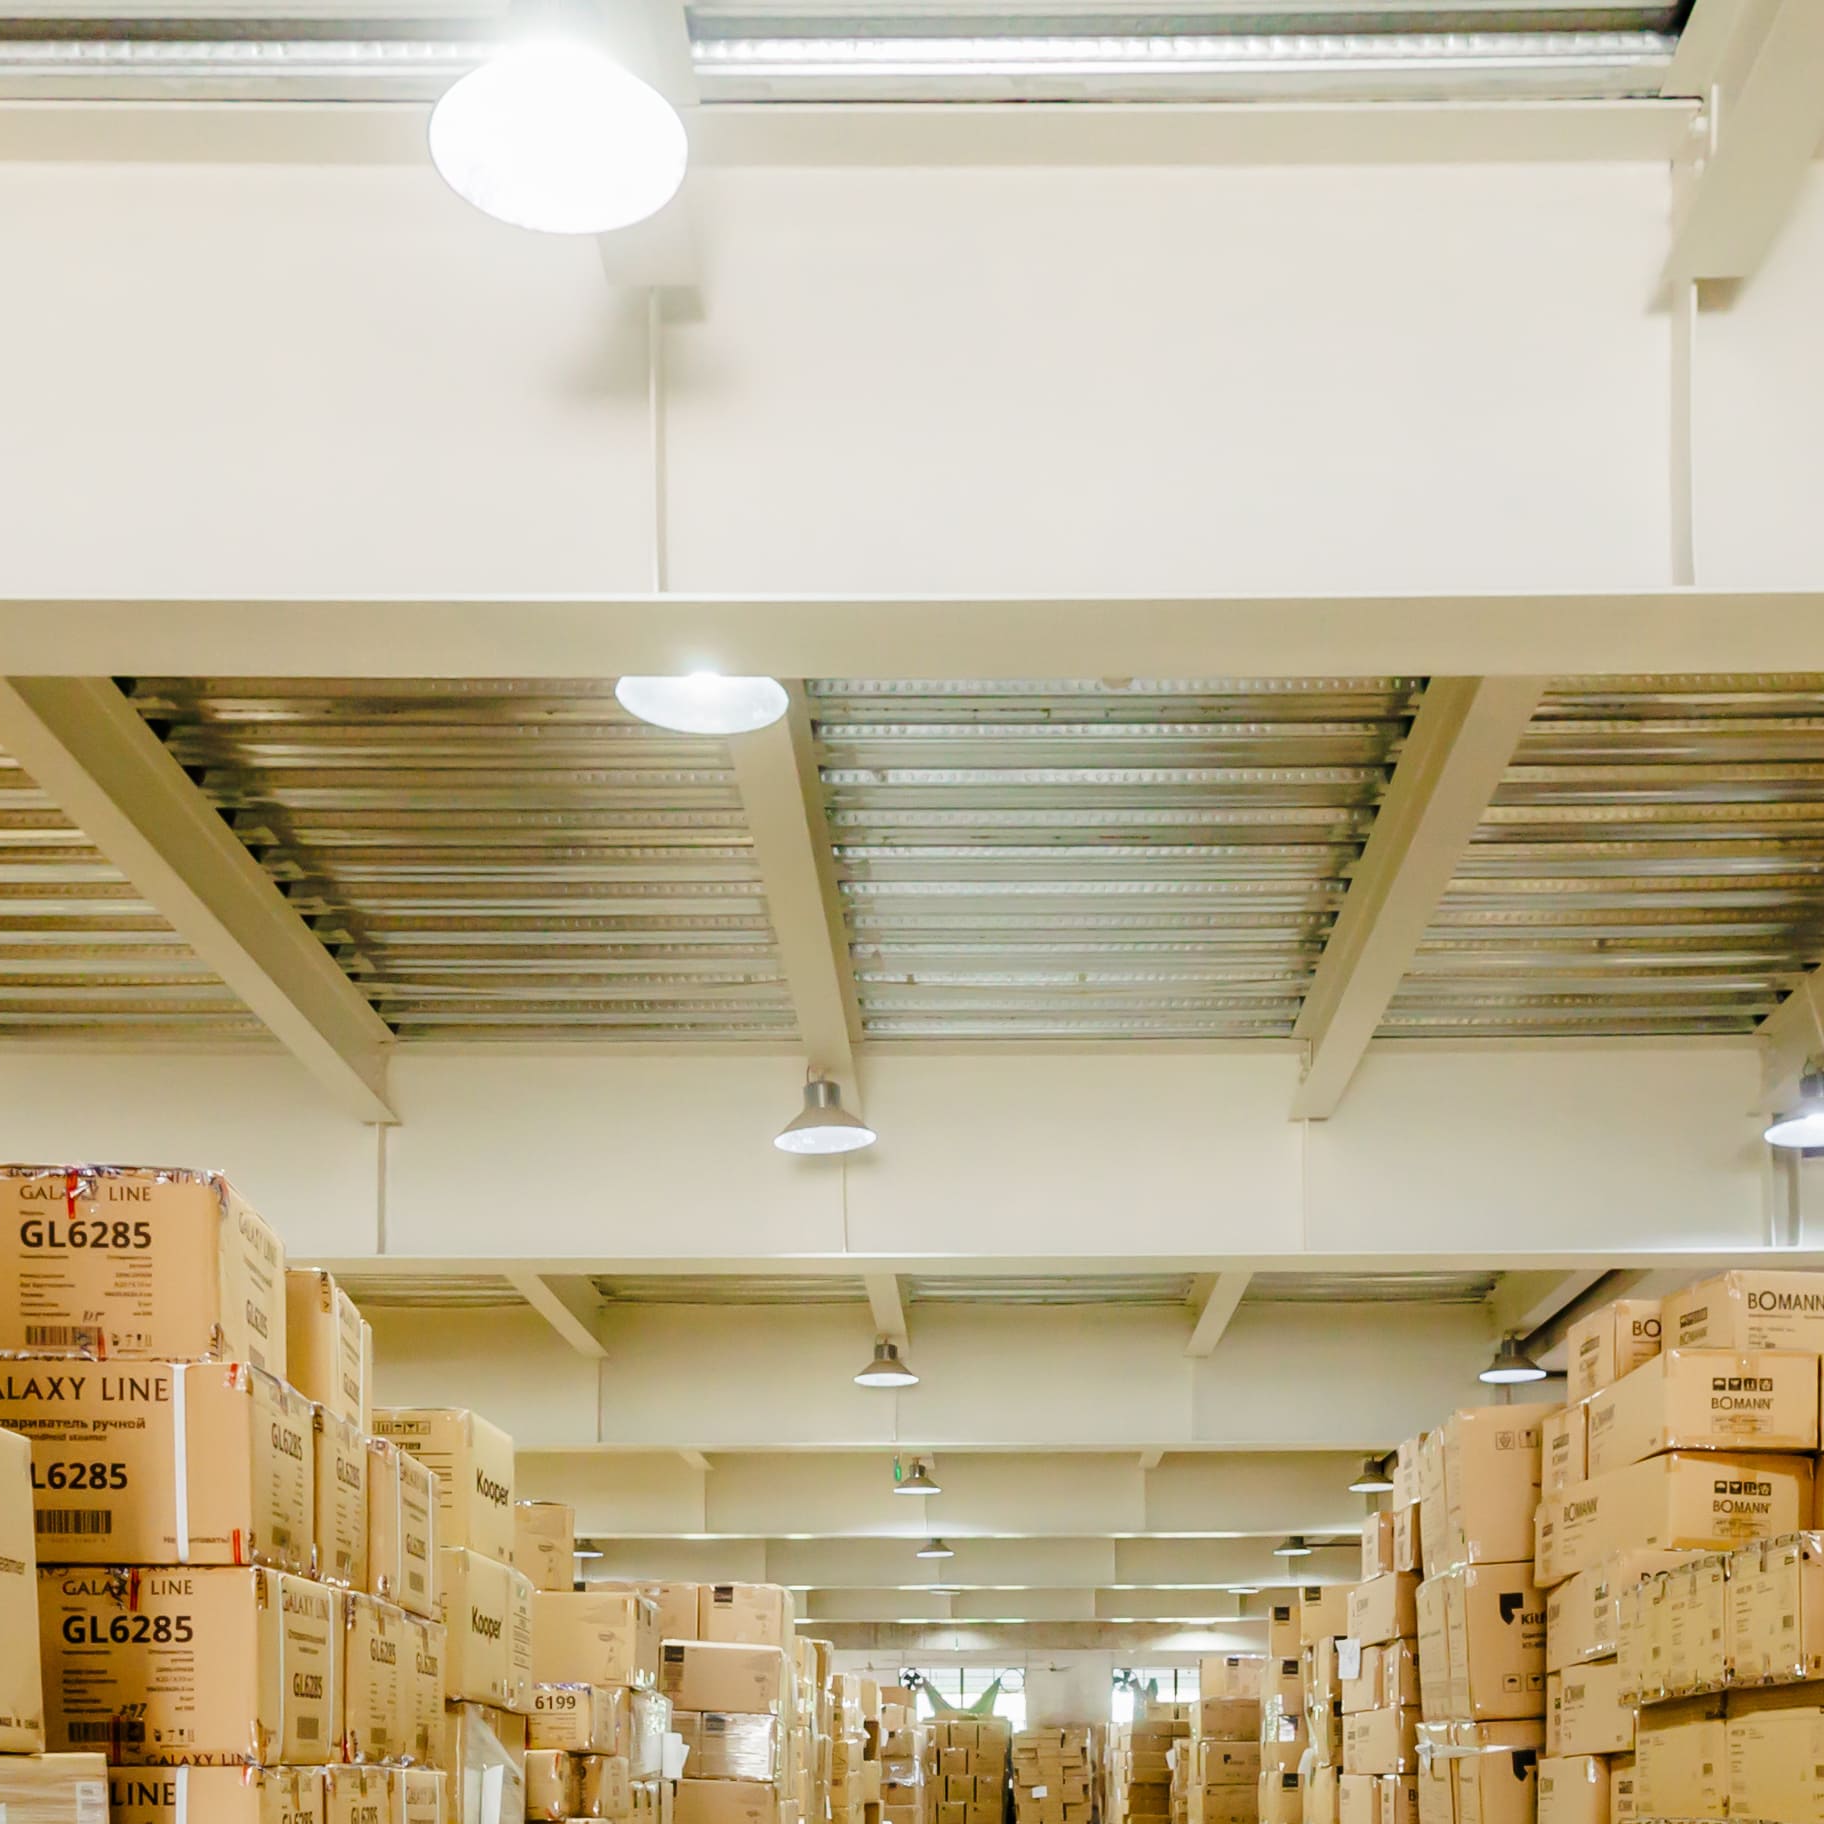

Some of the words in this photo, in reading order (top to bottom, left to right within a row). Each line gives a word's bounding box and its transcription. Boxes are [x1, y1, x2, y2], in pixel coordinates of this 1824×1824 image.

[21, 1220, 151, 1248] GL6285
[102, 1378, 169, 1401] LINE
[1712, 1396, 1773, 1411] BOMANN
[31, 1462, 128, 1490] L6285
[1713, 1500, 1771, 1513] BOMANN
[151, 1580, 194, 1595] LINE
[62, 1615, 194, 1644] GL6285
[535, 1696, 576, 1710] 6199
